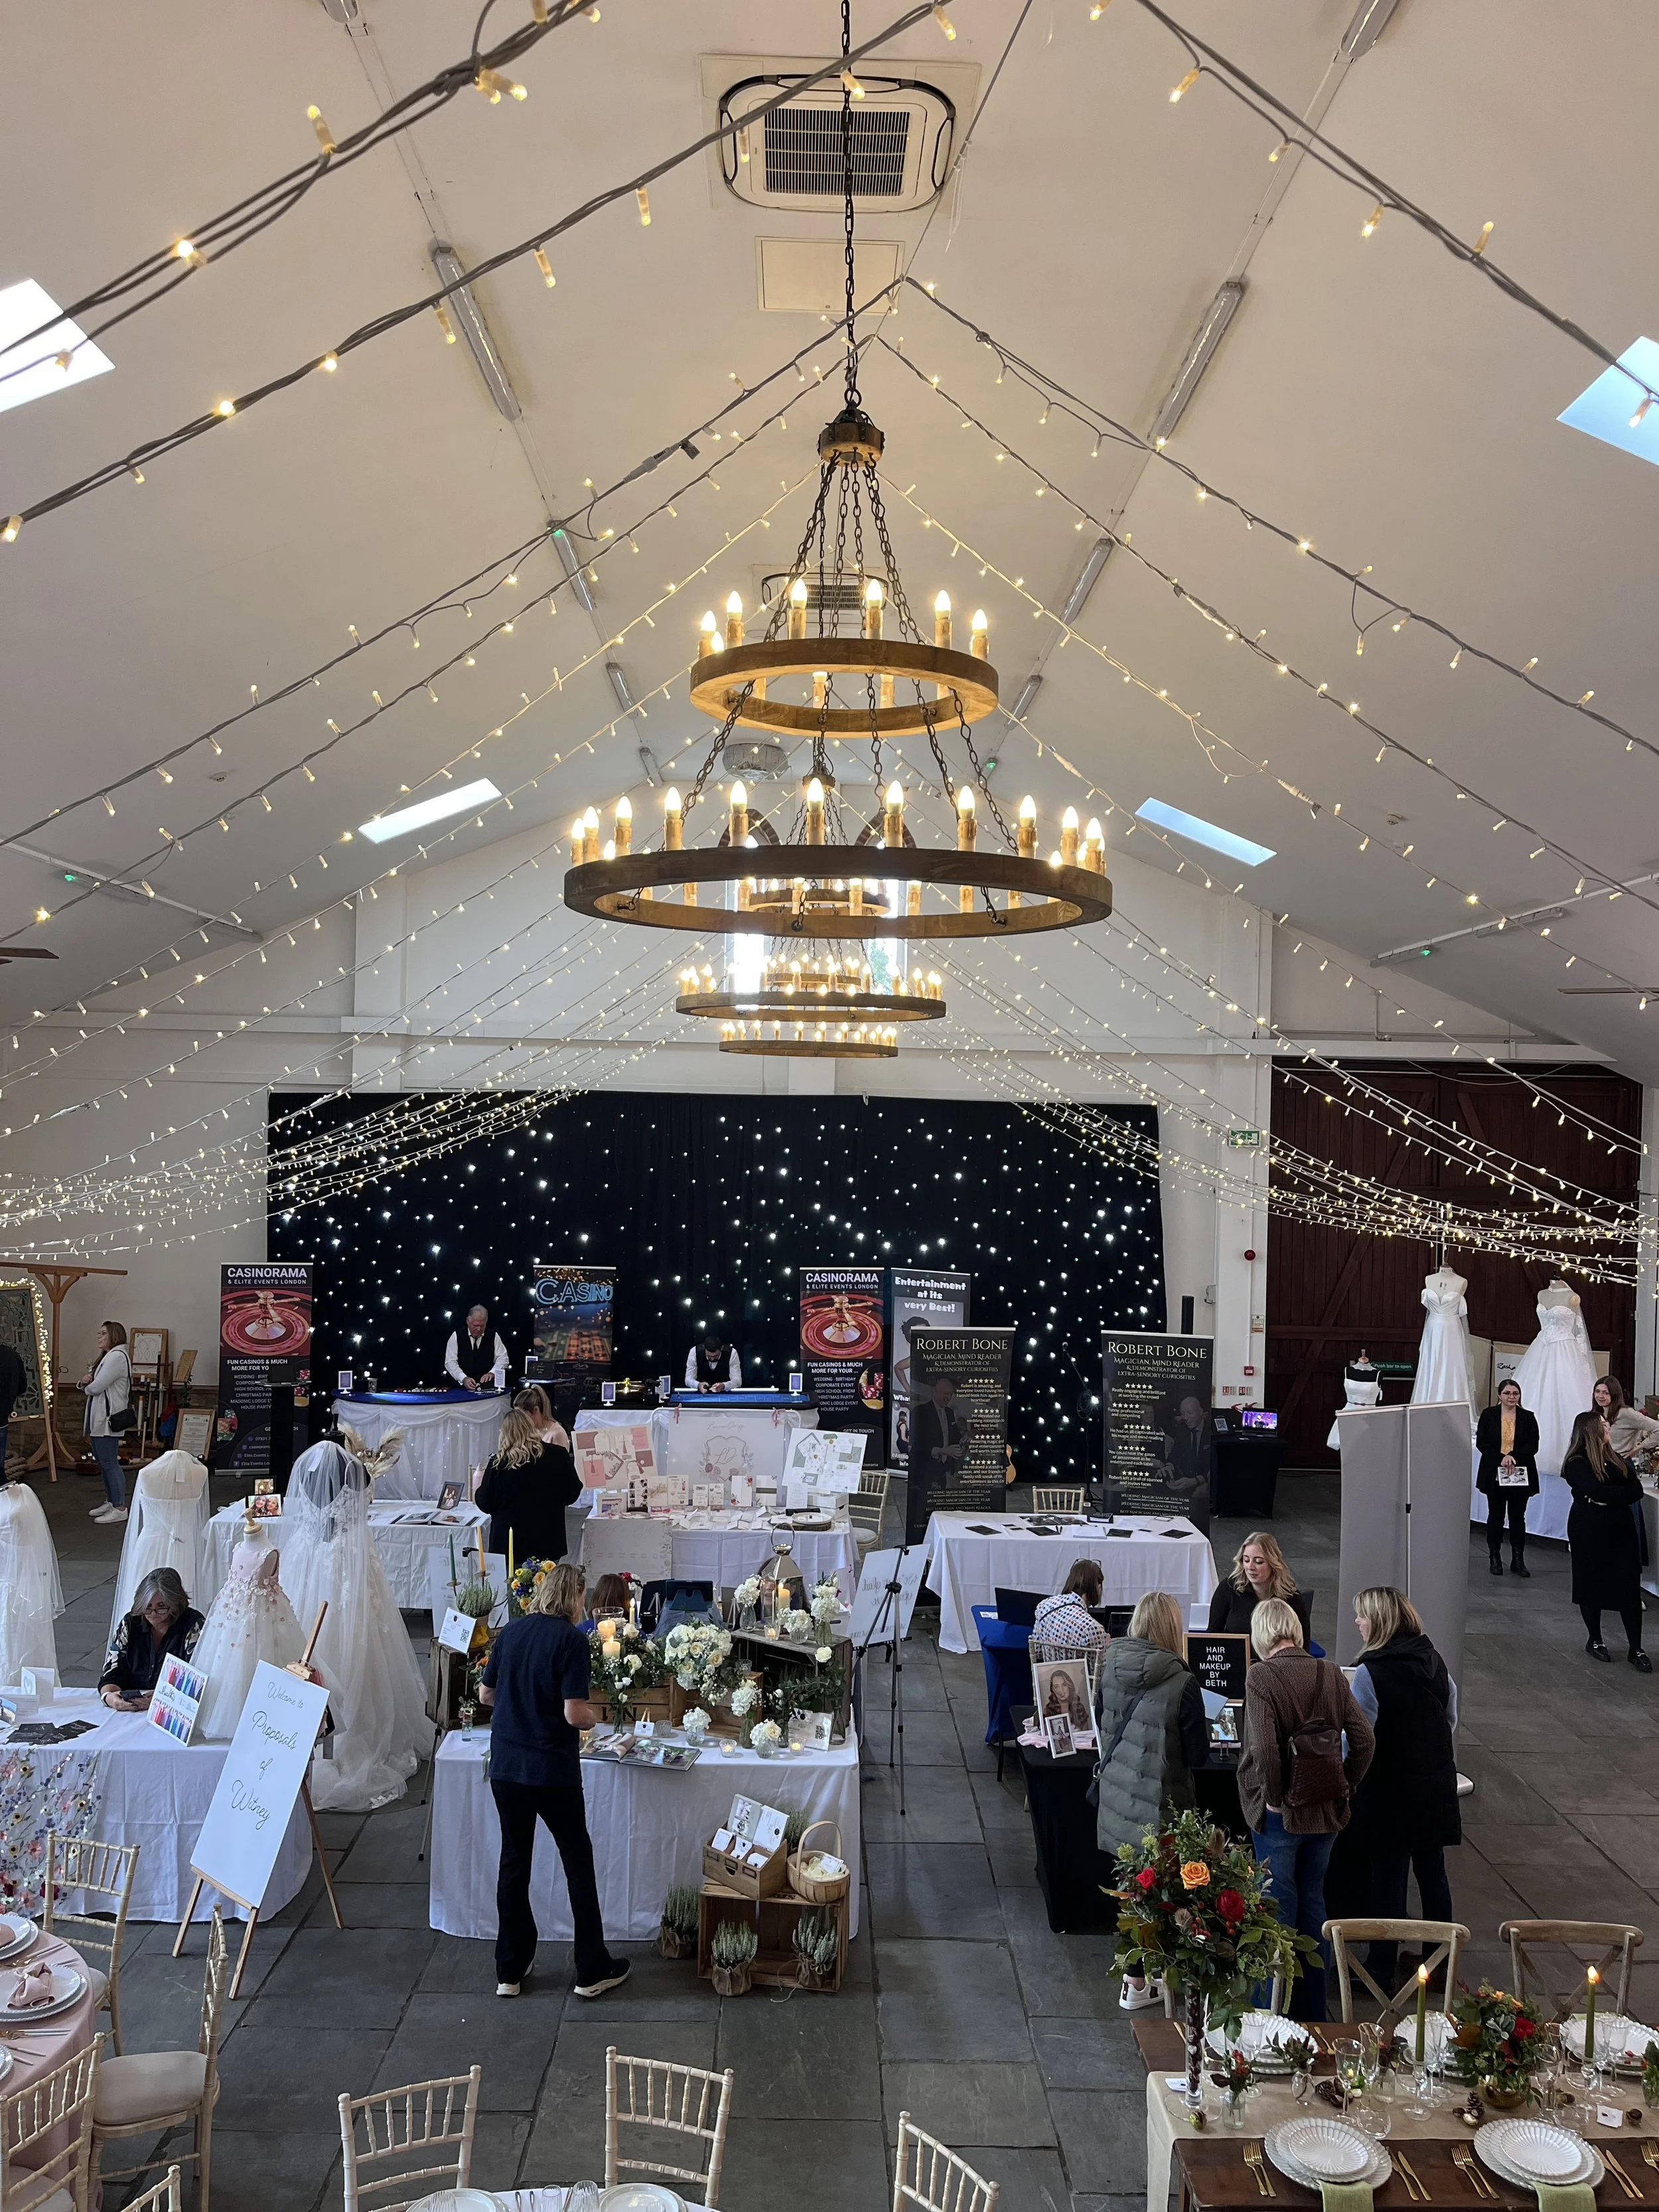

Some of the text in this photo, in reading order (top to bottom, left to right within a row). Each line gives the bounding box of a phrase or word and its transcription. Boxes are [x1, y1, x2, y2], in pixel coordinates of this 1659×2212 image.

[228, 1268, 307, 1278] CASINORAMA
[806, 1273, 879, 1282] CASINORAMA
[895, 1277, 966, 1290] Entertainment
[930, 1291, 942, 1299] its
[904, 1302, 955, 1313] very Best!
[267, 1681, 304, 1709] Welcome to
[252, 1710, 298, 1750] Proposals
[259, 1758, 273, 1780] of
[232, 1780, 270, 1830] Witney
